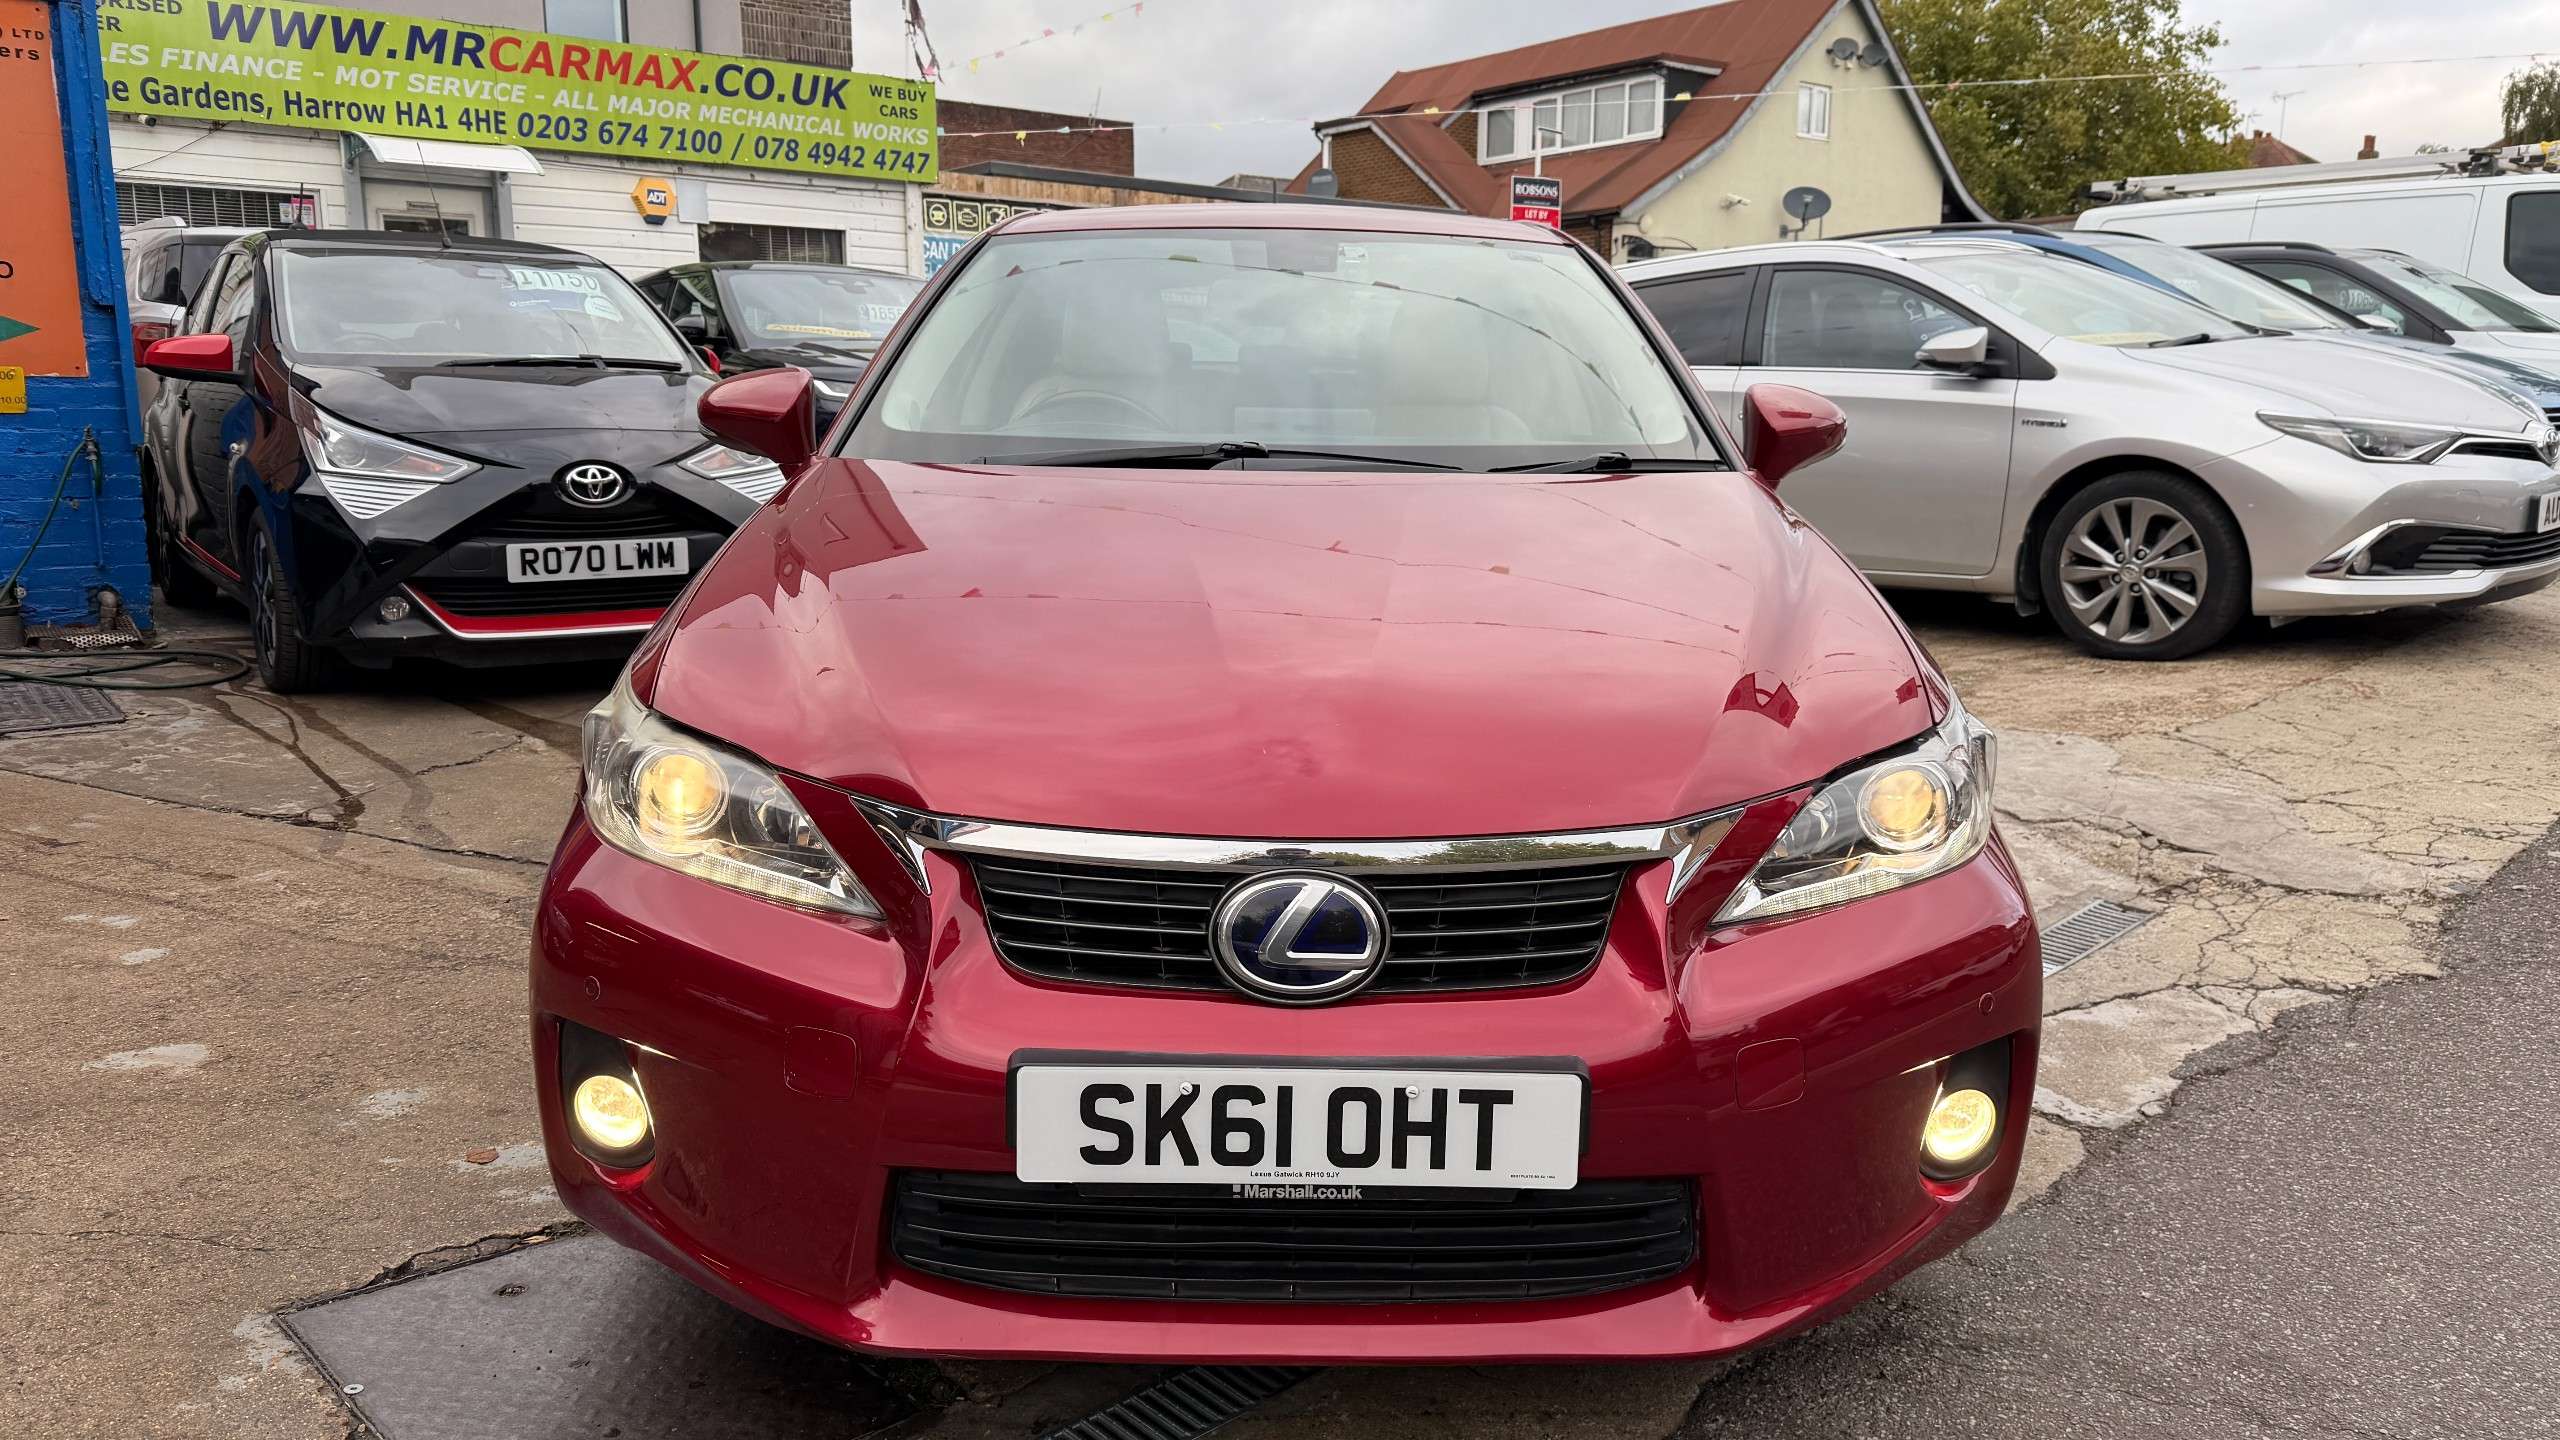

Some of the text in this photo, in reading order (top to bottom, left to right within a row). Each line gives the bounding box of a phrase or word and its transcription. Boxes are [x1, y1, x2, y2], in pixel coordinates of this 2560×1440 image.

[12, 28, 44, 40] LTD
[207, 1, 850, 110] WWW.MRCARMAX.CO.UK
[161, 48, 303, 81] FINANCE
[335, 66, 399, 90] MOT
[407, 73, 528, 103] SERVICE
[553, 89, 599, 112] ALL
[607, 94, 691, 121] MAJOR
[698, 104, 845, 136] MECHANICAL
[853, 121, 930, 145] WORKS
[869, 84, 927, 103] WE BUY
[879, 104, 919, 120] CARS
[139, 77, 273, 120] Gardens,
[283, 89, 386, 124] Harrow
[395, 100, 448, 130] HA1
[458, 107, 507, 135] 4HE
[517, 112, 588, 142] 0203
[599, 120, 648, 148] 674
[658, 126, 723, 155] 7100
[754, 135, 800, 162] 078
[807, 142, 865, 168] 4942
[873, 148, 930, 174] 4747
[647, 191, 666, 205] ADT
[2543, 495, 2560, 526] AU
[615, 541, 676, 571] LWM
[1079, 1083, 1514, 1171] SK61 OHT
[1250, 1170, 1272, 1178] Lexus
[1274, 1170, 1303, 1178] Gatwick
[1244, 1184, 1363, 1200] Marshall.co.uk
